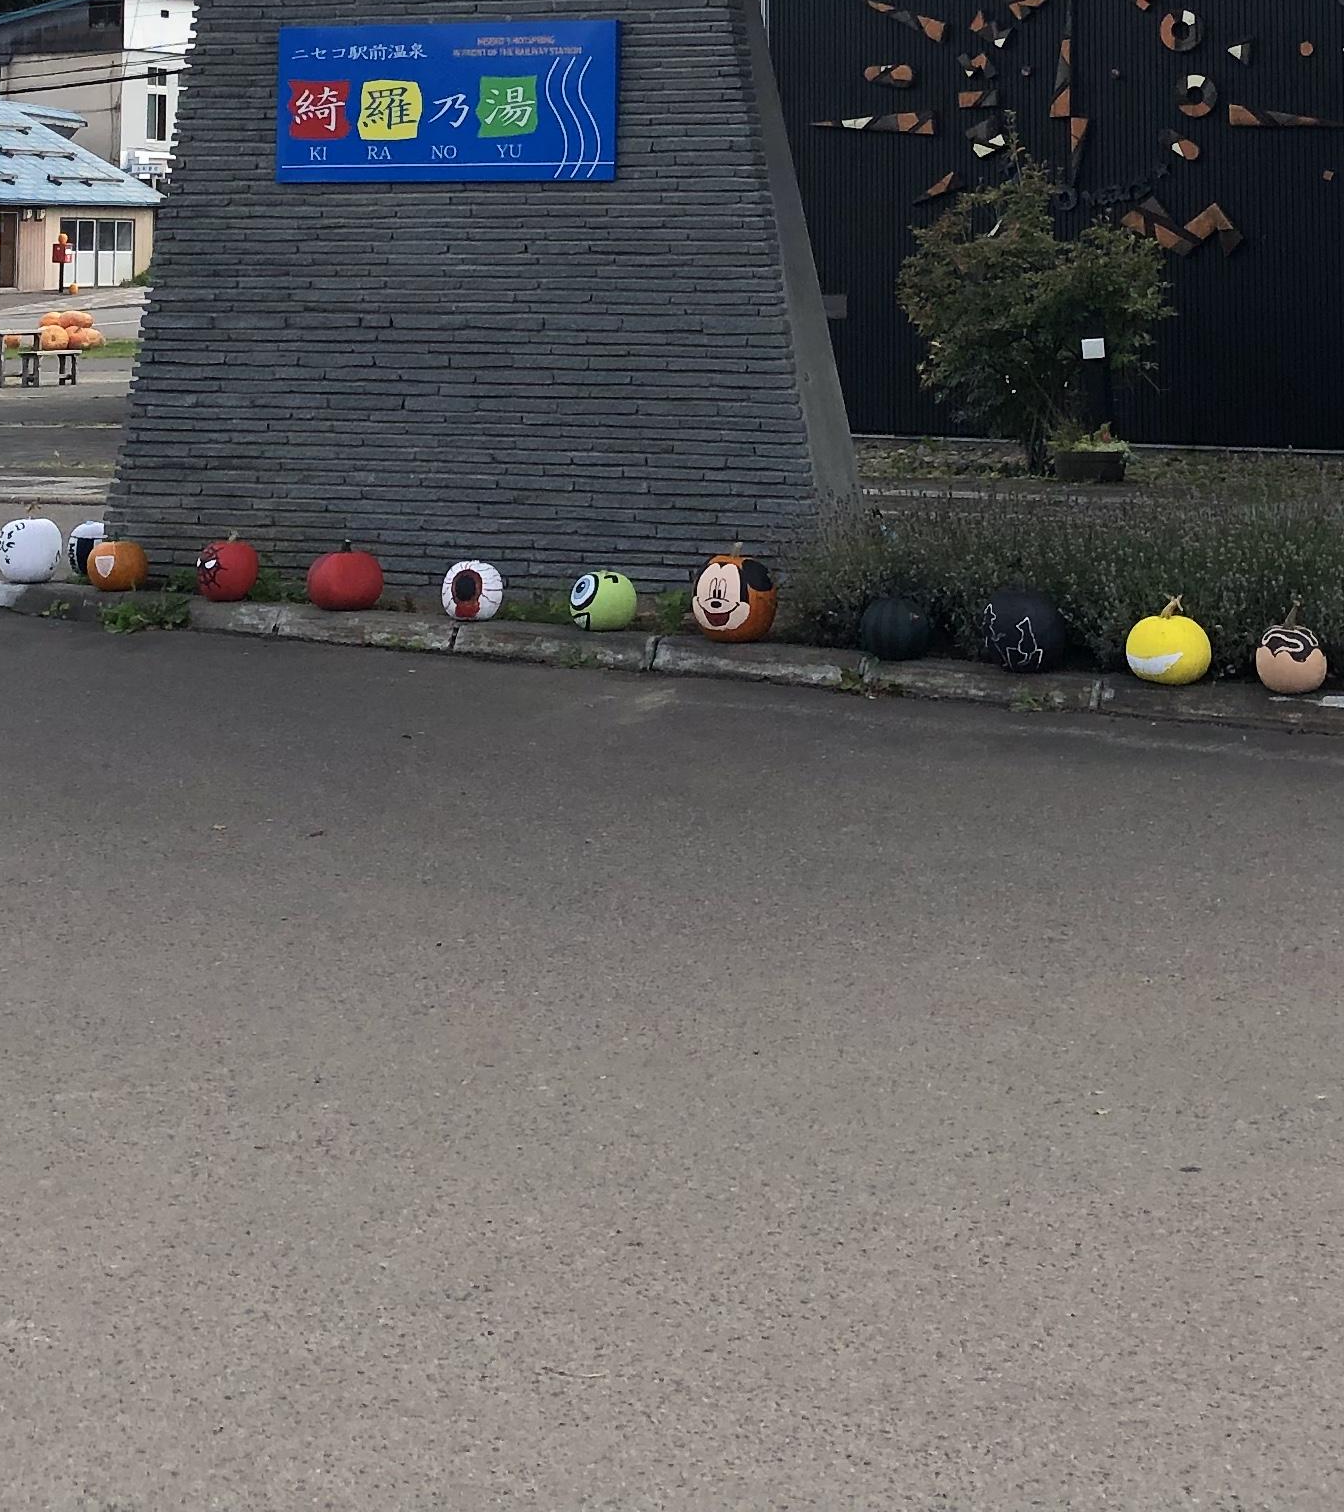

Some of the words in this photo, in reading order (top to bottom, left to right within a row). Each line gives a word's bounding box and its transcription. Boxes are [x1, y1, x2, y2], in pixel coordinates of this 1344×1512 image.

[291, 42, 428, 61] ニセコ駅前温泉
[295, 86, 536, 131] 綺羅乃湯
[309, 146, 327, 161] KI
[367, 146, 392, 160] RA
[431, 145, 457, 159] NO
[496, 144, 523, 158] YU
